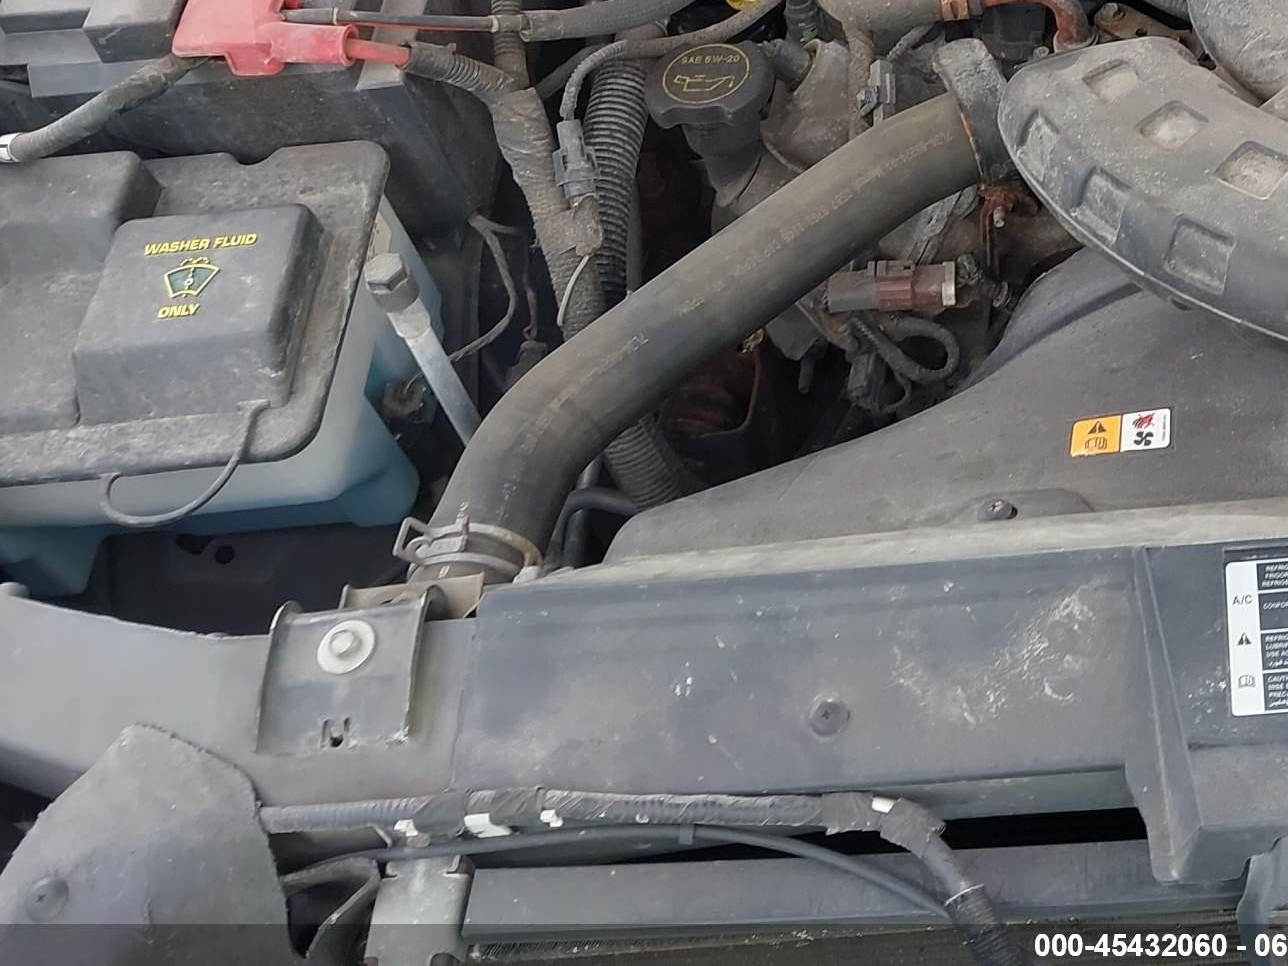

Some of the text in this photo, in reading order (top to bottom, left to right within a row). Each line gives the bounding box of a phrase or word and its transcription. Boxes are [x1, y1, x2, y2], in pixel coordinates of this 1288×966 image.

[681, 55, 740, 65] SAE 5W-20
[144, 234, 257, 255] WASHER FLUID
[158, 303, 200, 318] ONLY
[1232, 594, 1253, 605] A/C
